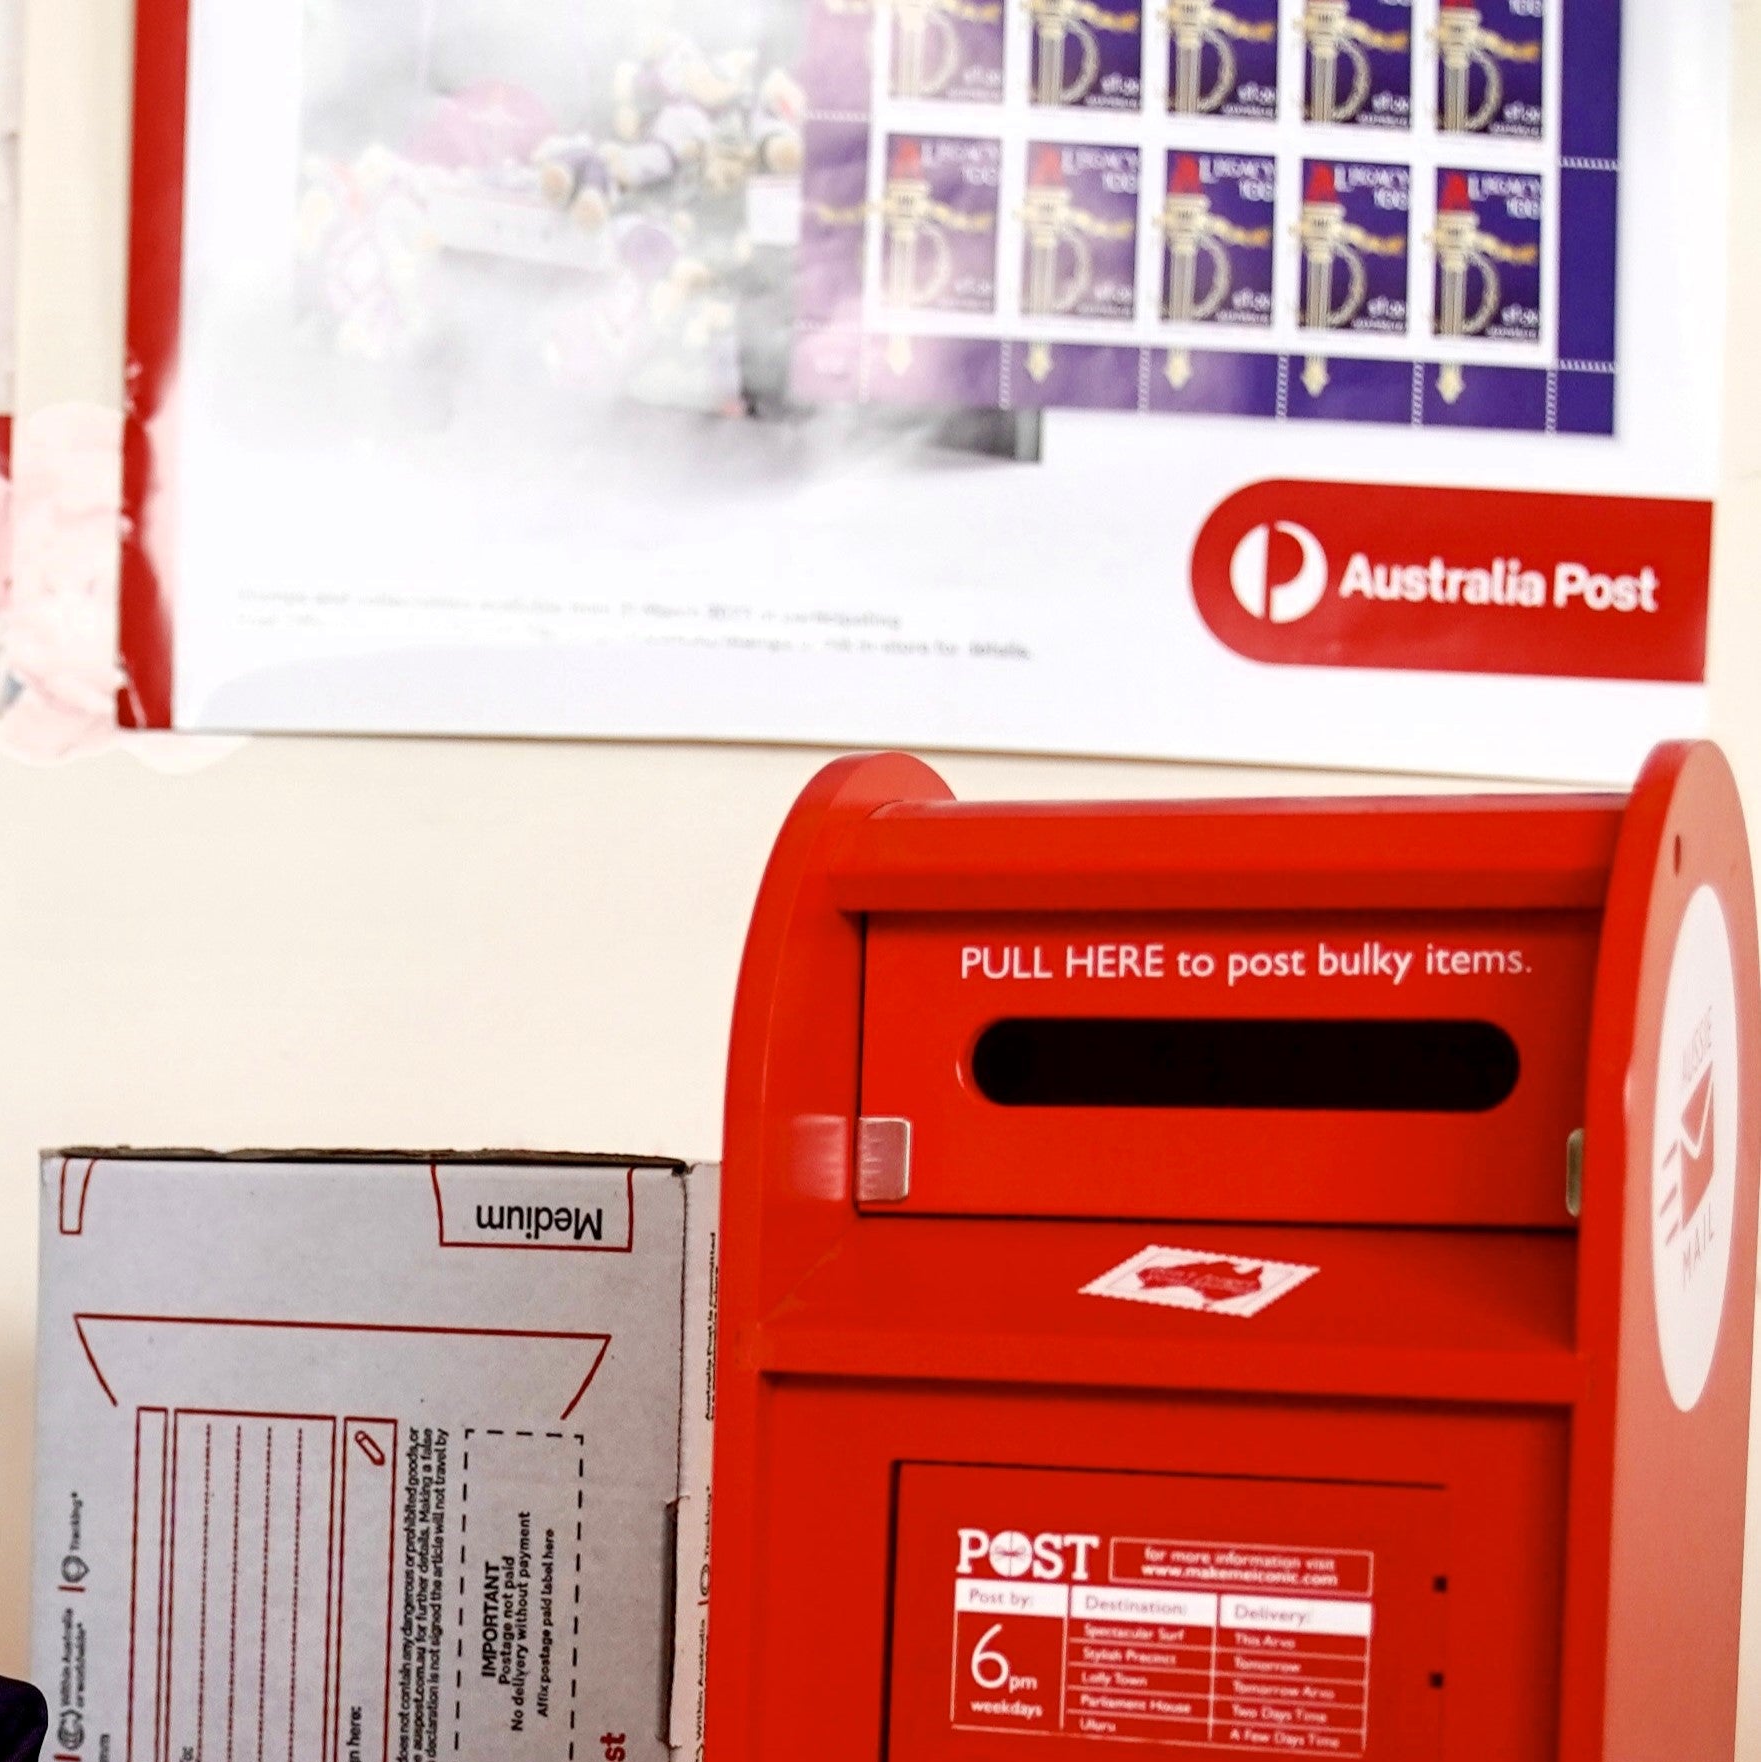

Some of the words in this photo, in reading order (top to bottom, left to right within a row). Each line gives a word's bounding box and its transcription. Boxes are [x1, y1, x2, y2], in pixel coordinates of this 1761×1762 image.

[1338, 552, 1547, 609] Australia
[1552, 561, 1660, 614] Post
[961, 946, 1053, 980] PULL
[1066, 944, 1165, 978] HERE
[1177, 954, 1215, 978] to
[1228, 950, 1306, 986] post
[1317, 943, 1414, 985] bulky
[1425, 942, 1533, 976] items.
[475, 1204, 604, 1242] Medium
[1682, 1201, 1715, 1292] MAIL
[434, 1427, 449, 1447] by
[418, 1476, 433, 1523] Making
[517, 1510, 531, 1580] payment
[542, 1528, 556, 1560] here
[955, 1527, 1101, 1581] POST
[1144, 1547, 1165, 1562] for
[1170, 1550, 1212, 1564] more
[1214, 1551, 1301, 1569] information
[1305, 1557, 1335, 1571] visit
[501, 1556, 517, 1590] paid
[541, 1561, 554, 1595] label
[501, 1592, 514, 1619] not
[515, 1582, 530, 1641] without
[969, 1587, 1005, 1605] Post
[481, 1561, 501, 1678] IMPORTANT
[540, 1597, 554, 1628] paid
[1158, 1627, 1185, 1641] Surf
[498, 1622, 516, 1686] Postage
[538, 1629, 554, 1684] postage
[1233, 1656, 1301, 1673] Tomorrow
[512, 1644, 530, 1706] delivery
[1113, 1672, 1148, 1686] Town
[1232, 1679, 1300, 1697] Tomorrow
[536, 1685, 550, 1718] Affix
[970, 1699, 1044, 1720] weekdays
[1149, 1700, 1192, 1714] House
[1260, 1706, 1293, 1723] Days
[1295, 1708, 1327, 1723] Time
[510, 1708, 525, 1732] No
[1274, 1731, 1305, 1748] Days
